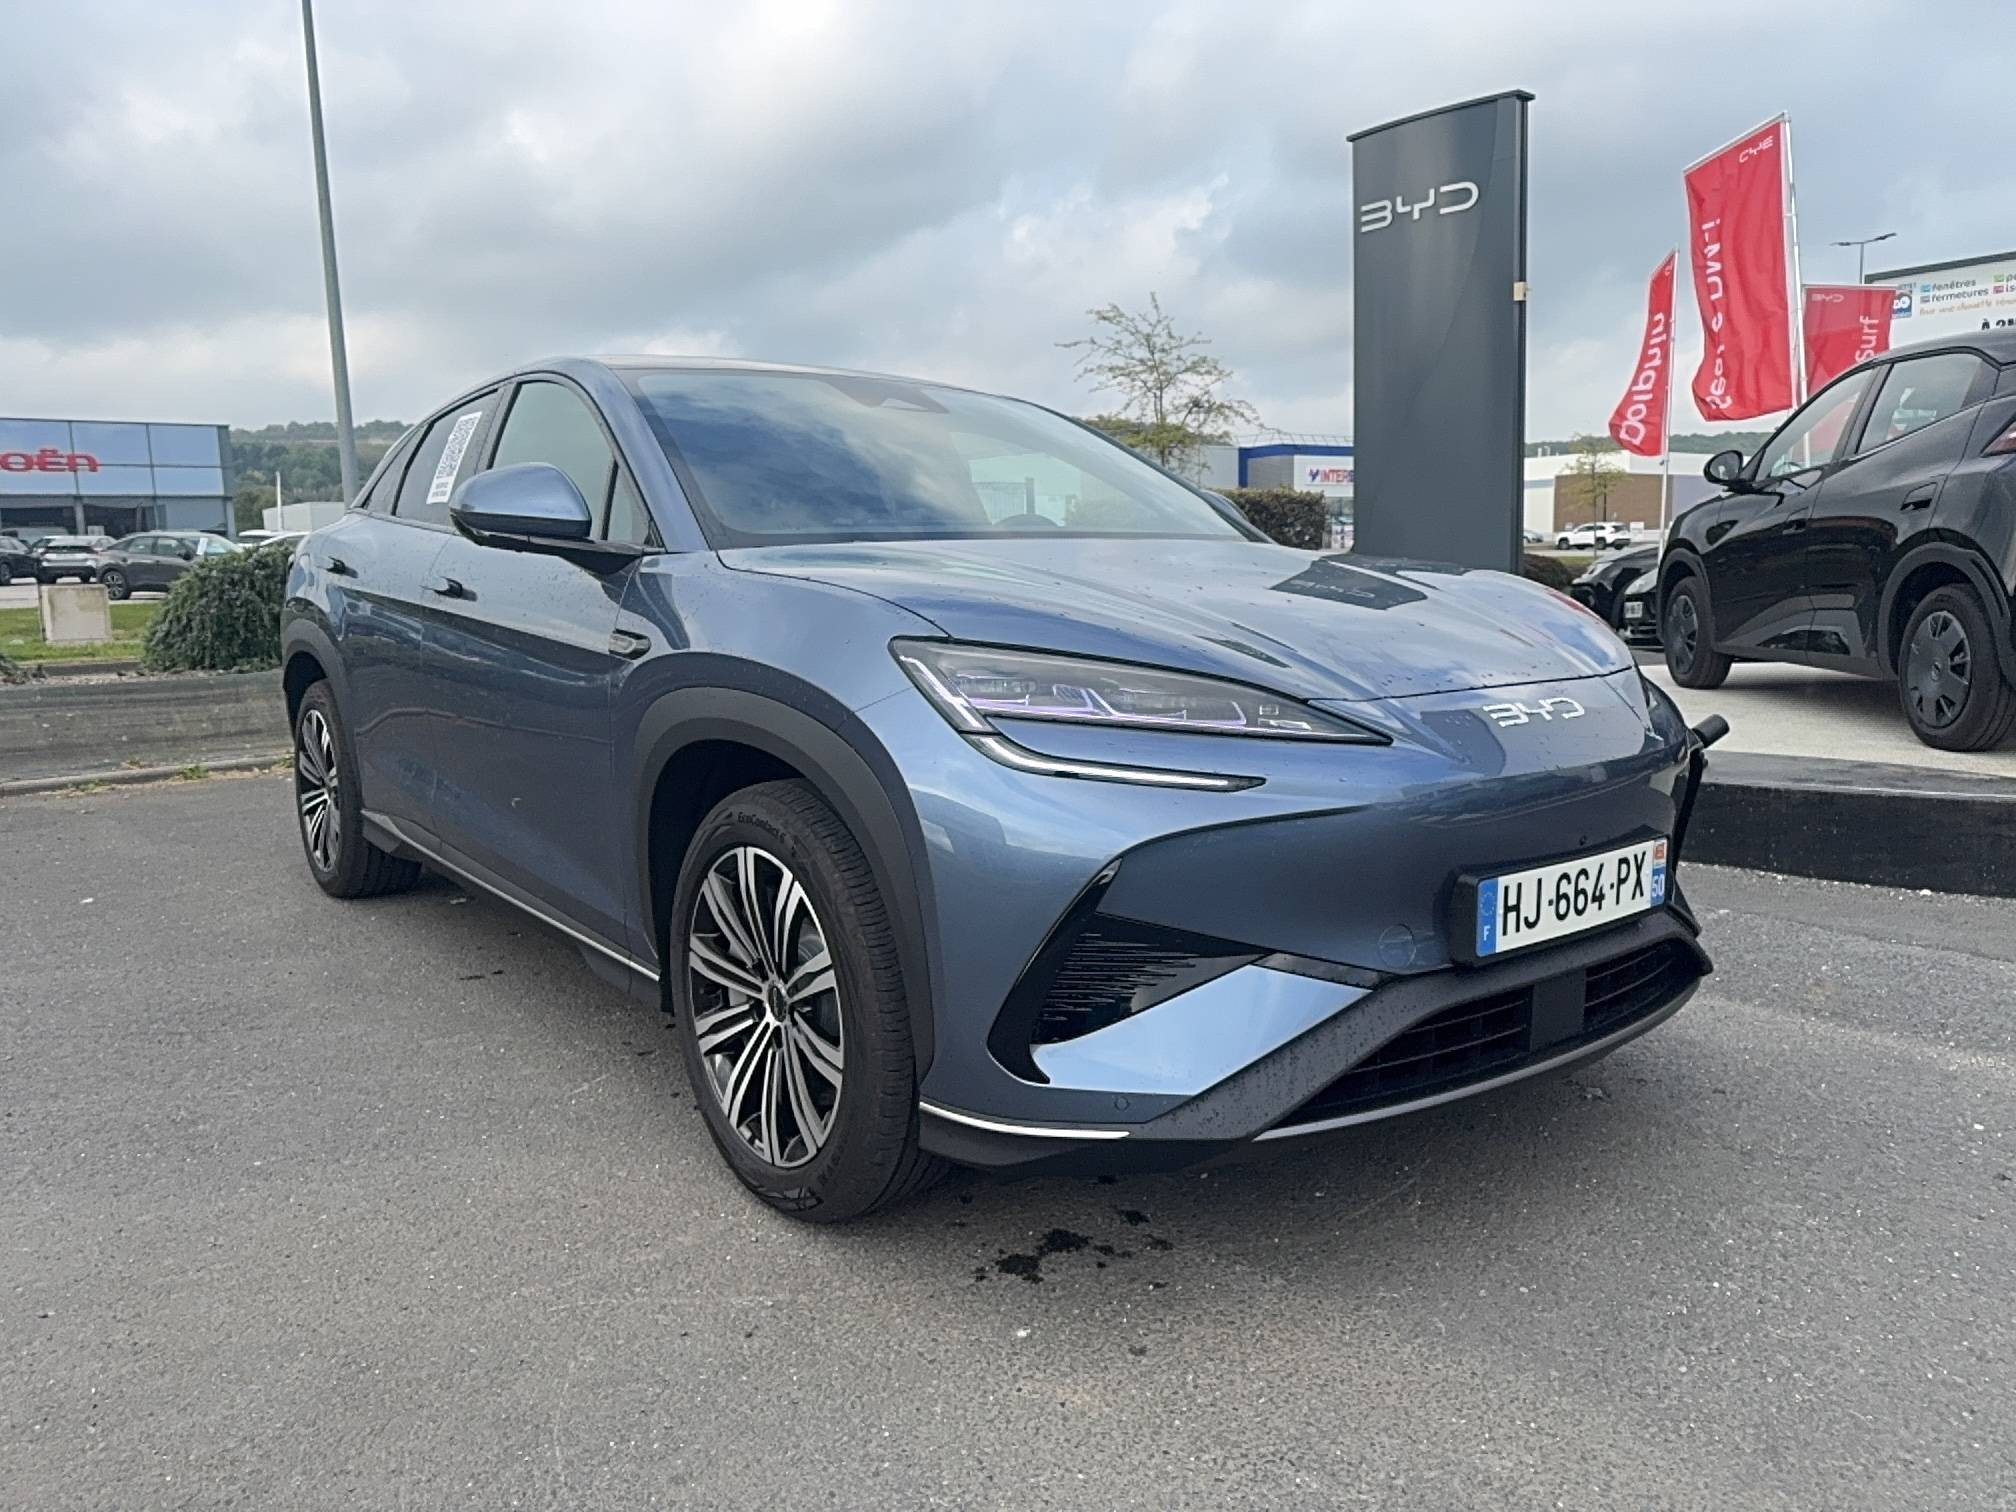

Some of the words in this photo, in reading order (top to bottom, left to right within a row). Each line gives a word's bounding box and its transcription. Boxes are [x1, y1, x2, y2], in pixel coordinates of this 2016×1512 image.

[1360, 181, 1479, 233] BYD
[1931, 288, 1989, 302] fermetures
[1932, 280, 1976, 291] fenêtres
[1855, 315, 1879, 363] Surf
[1482, 697, 1585, 728] BYD
[1651, 874, 1665, 897] 50
[1483, 925, 1491, 942] F
